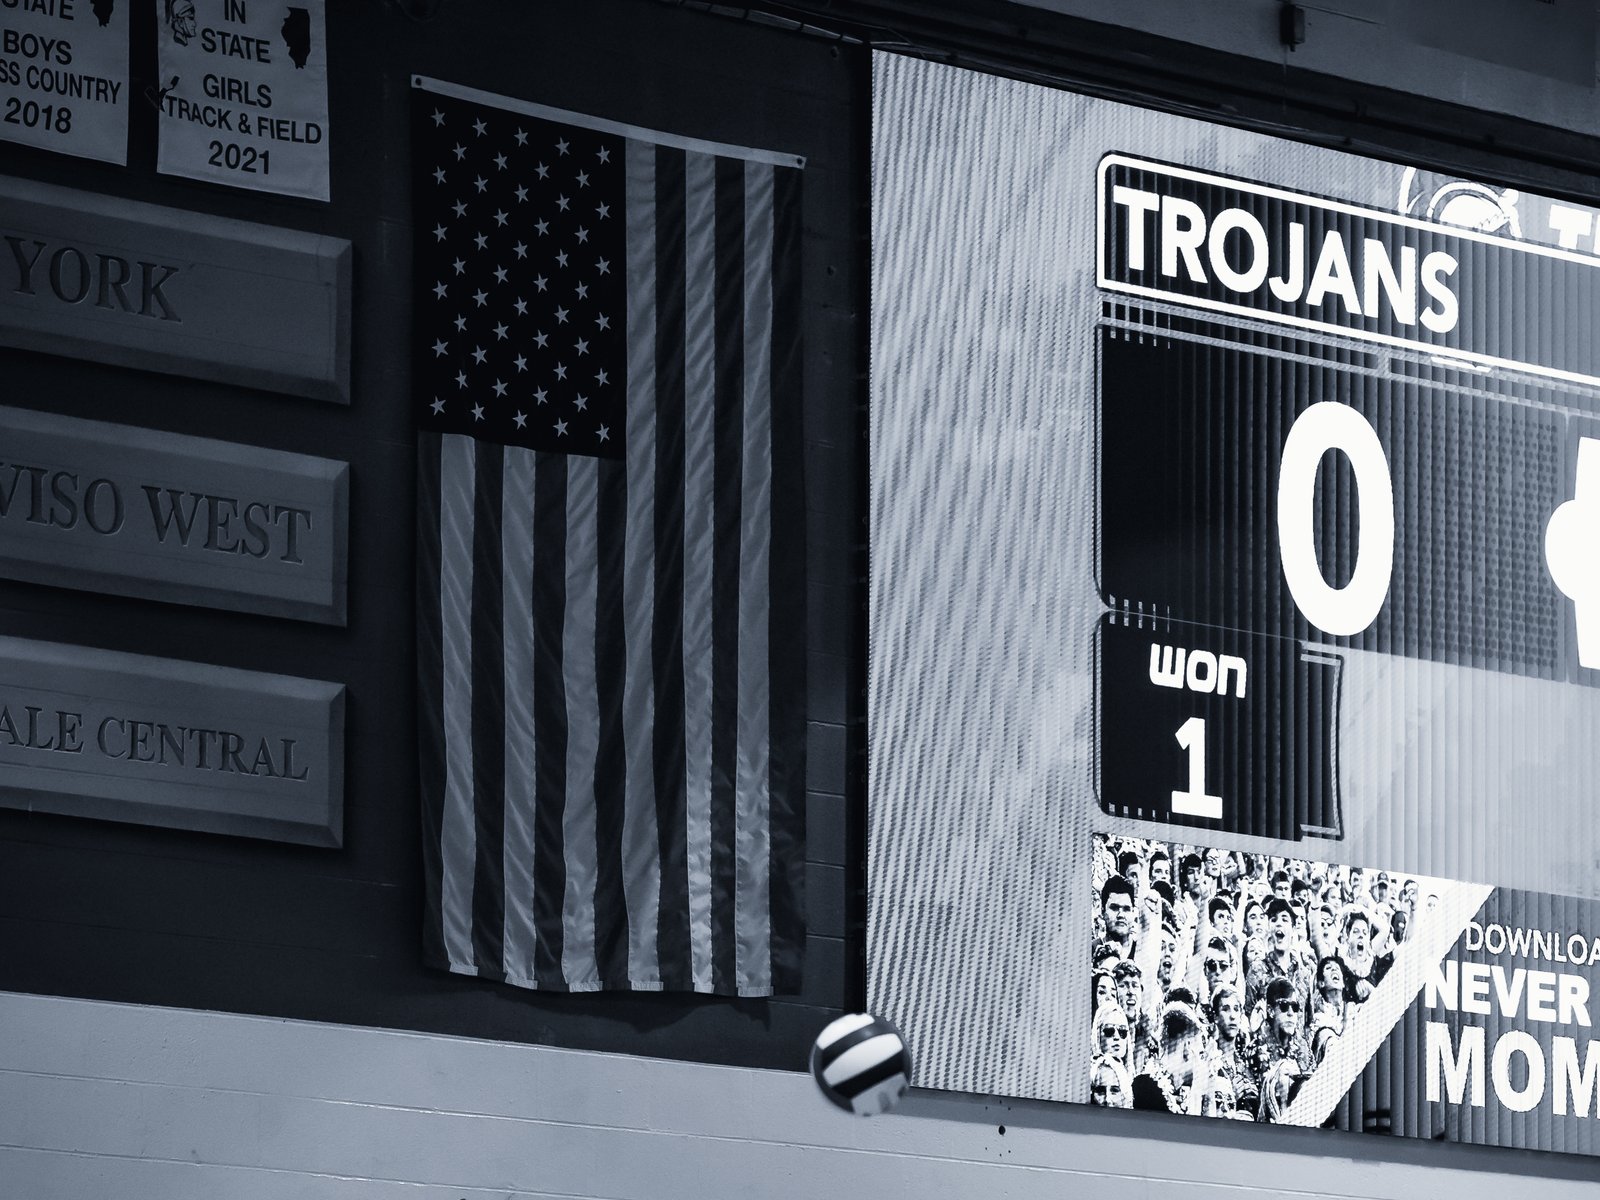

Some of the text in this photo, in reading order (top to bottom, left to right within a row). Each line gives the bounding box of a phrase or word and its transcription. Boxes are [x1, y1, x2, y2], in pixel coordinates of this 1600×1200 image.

[224, 0, 246, 24] IN
[3, 29, 73, 65] BOYS
[201, 28, 271, 64] STATE
[26, 65, 122, 104] COUNTRY
[203, 74, 272, 108] GIRLS
[3, 97, 72, 134] 2018
[165, 95, 322, 144] TRACK & FIELD
[208, 140, 270, 175] 2021
[4, 235, 183, 323] YORK
[1113, 185, 1459, 333] TROJANS
[141, 485, 312, 565] WEST
[1277, 401, 1394, 636] 0
[97, 716, 309, 782] CENTRAL
[1171, 717, 1223, 819] 1
[1425, 957, 1592, 1027] NEVER
[1426, 1021, 1600, 1119] MOM
